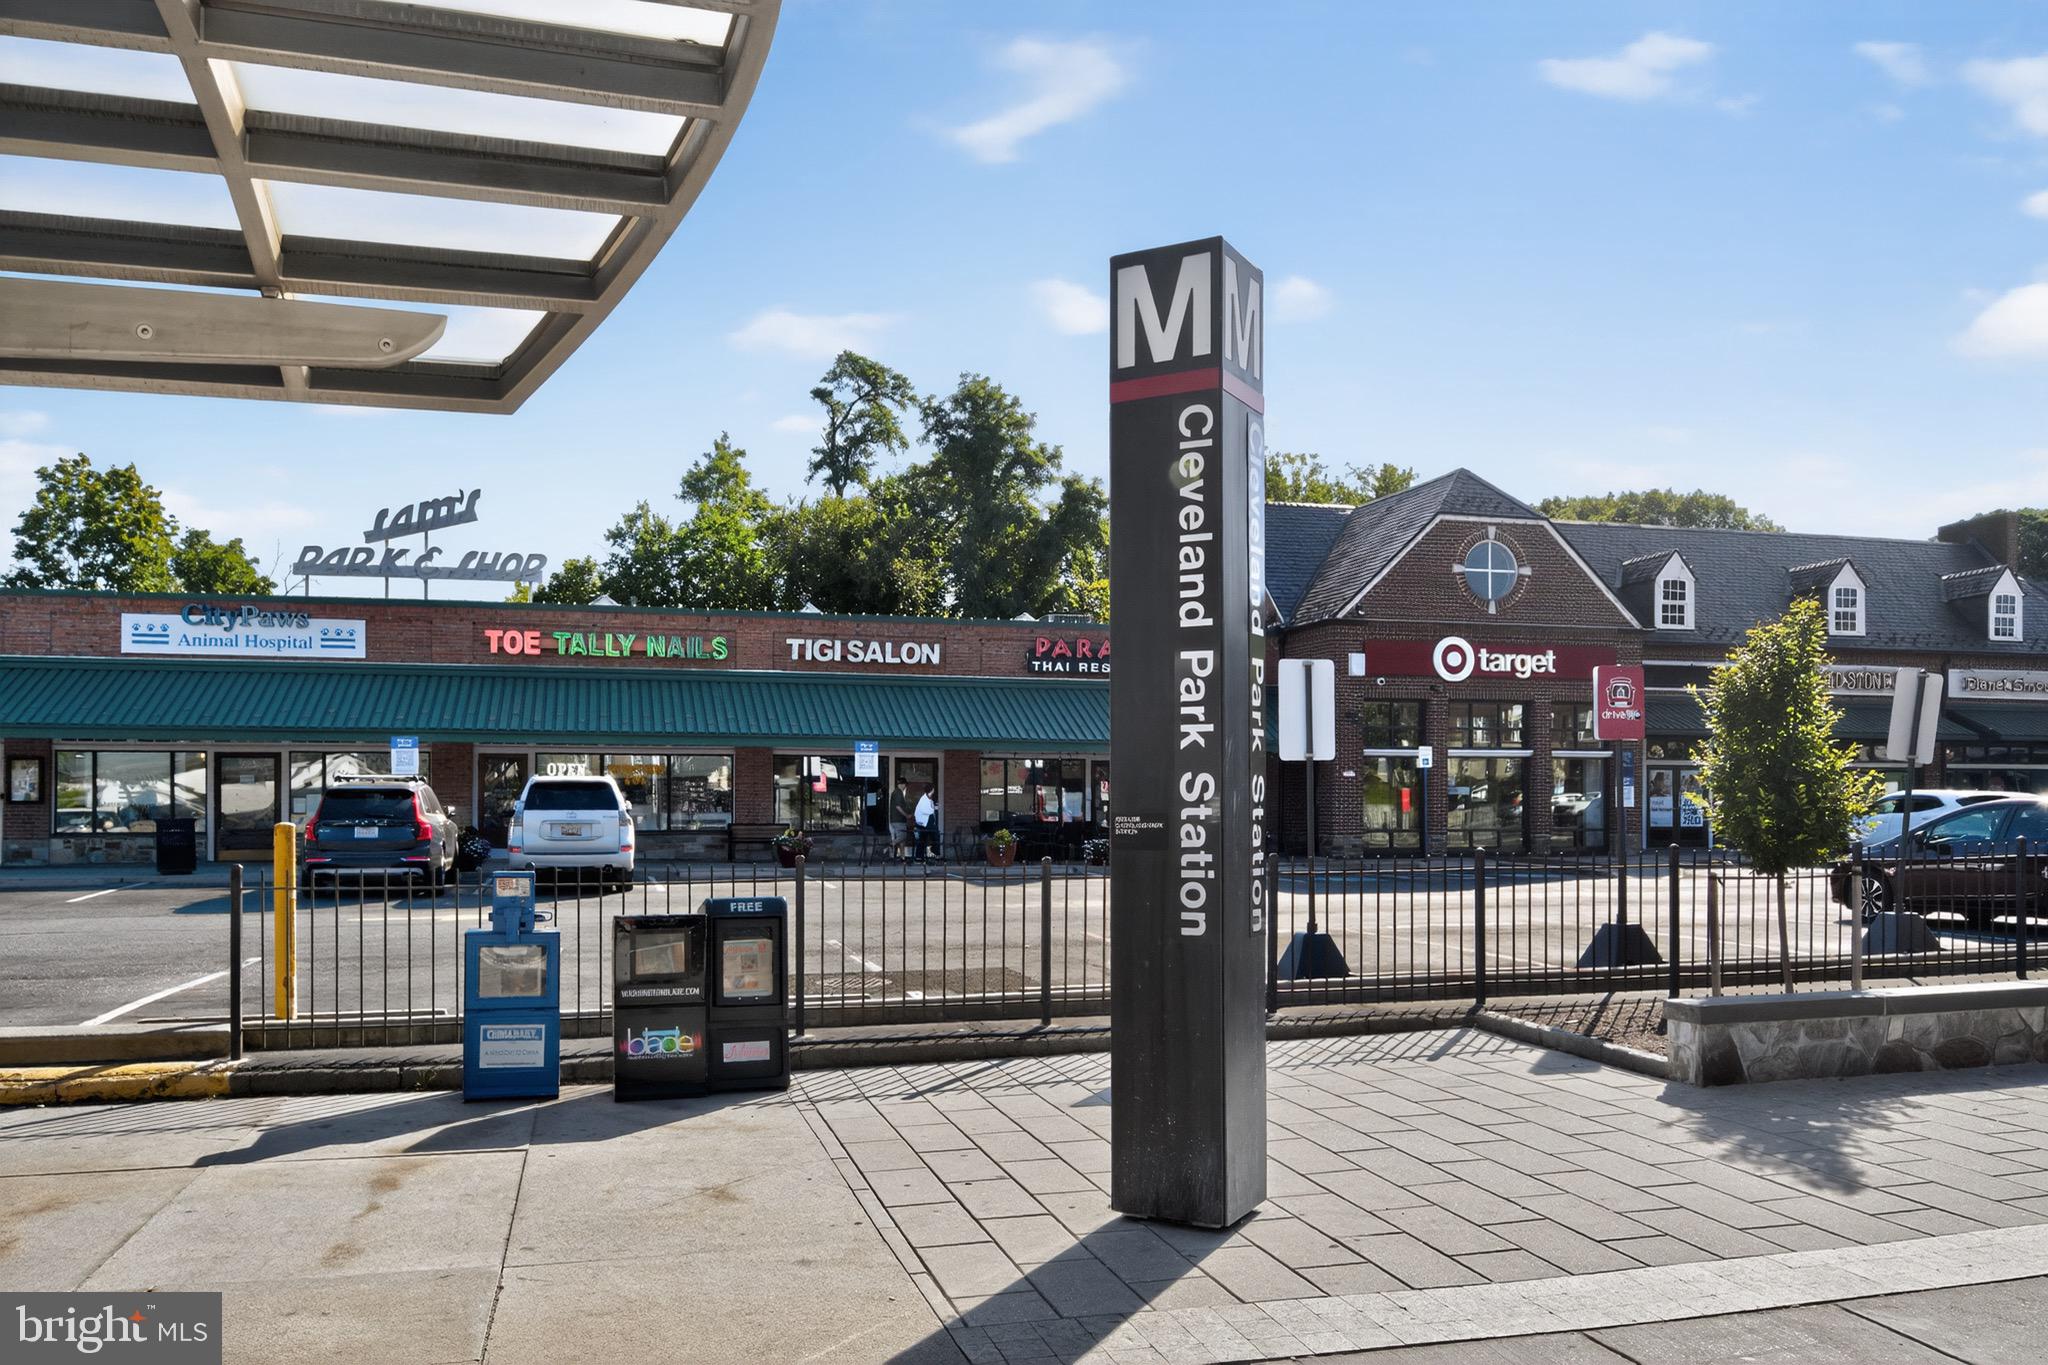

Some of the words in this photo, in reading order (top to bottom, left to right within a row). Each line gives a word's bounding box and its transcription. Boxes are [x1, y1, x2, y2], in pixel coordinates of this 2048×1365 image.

[1118, 252, 1211, 369] M
[1225, 256, 1260, 380] M
[1178, 404, 1214, 628] Cleveland
[1250, 422, 1264, 637] Cleveland
[295, 545, 411, 577] PARK
[414, 546, 443, 579] &
[455, 550, 548, 581] SHOP
[178, 633, 239, 649] Animal
[245, 635, 313, 652] Hospital
[485, 629, 541, 655] TOE
[552, 631, 636, 657] TALLY
[646, 635, 728, 660] NAILS
[786, 638, 842, 661] TIGI
[846, 639, 940, 665] SALON
[1032, 661, 1070, 672] THAI
[1478, 648, 1556, 679] target
[1180, 650, 1214, 750] Park
[1251, 657, 1264, 752] Park
[547, 763, 586, 777] OPEN
[1179, 771, 1215, 936] Station
[1251, 774, 1265, 933] Station
[730, 901, 763, 912] FREE
[627, 1025, 695, 1056] blade
